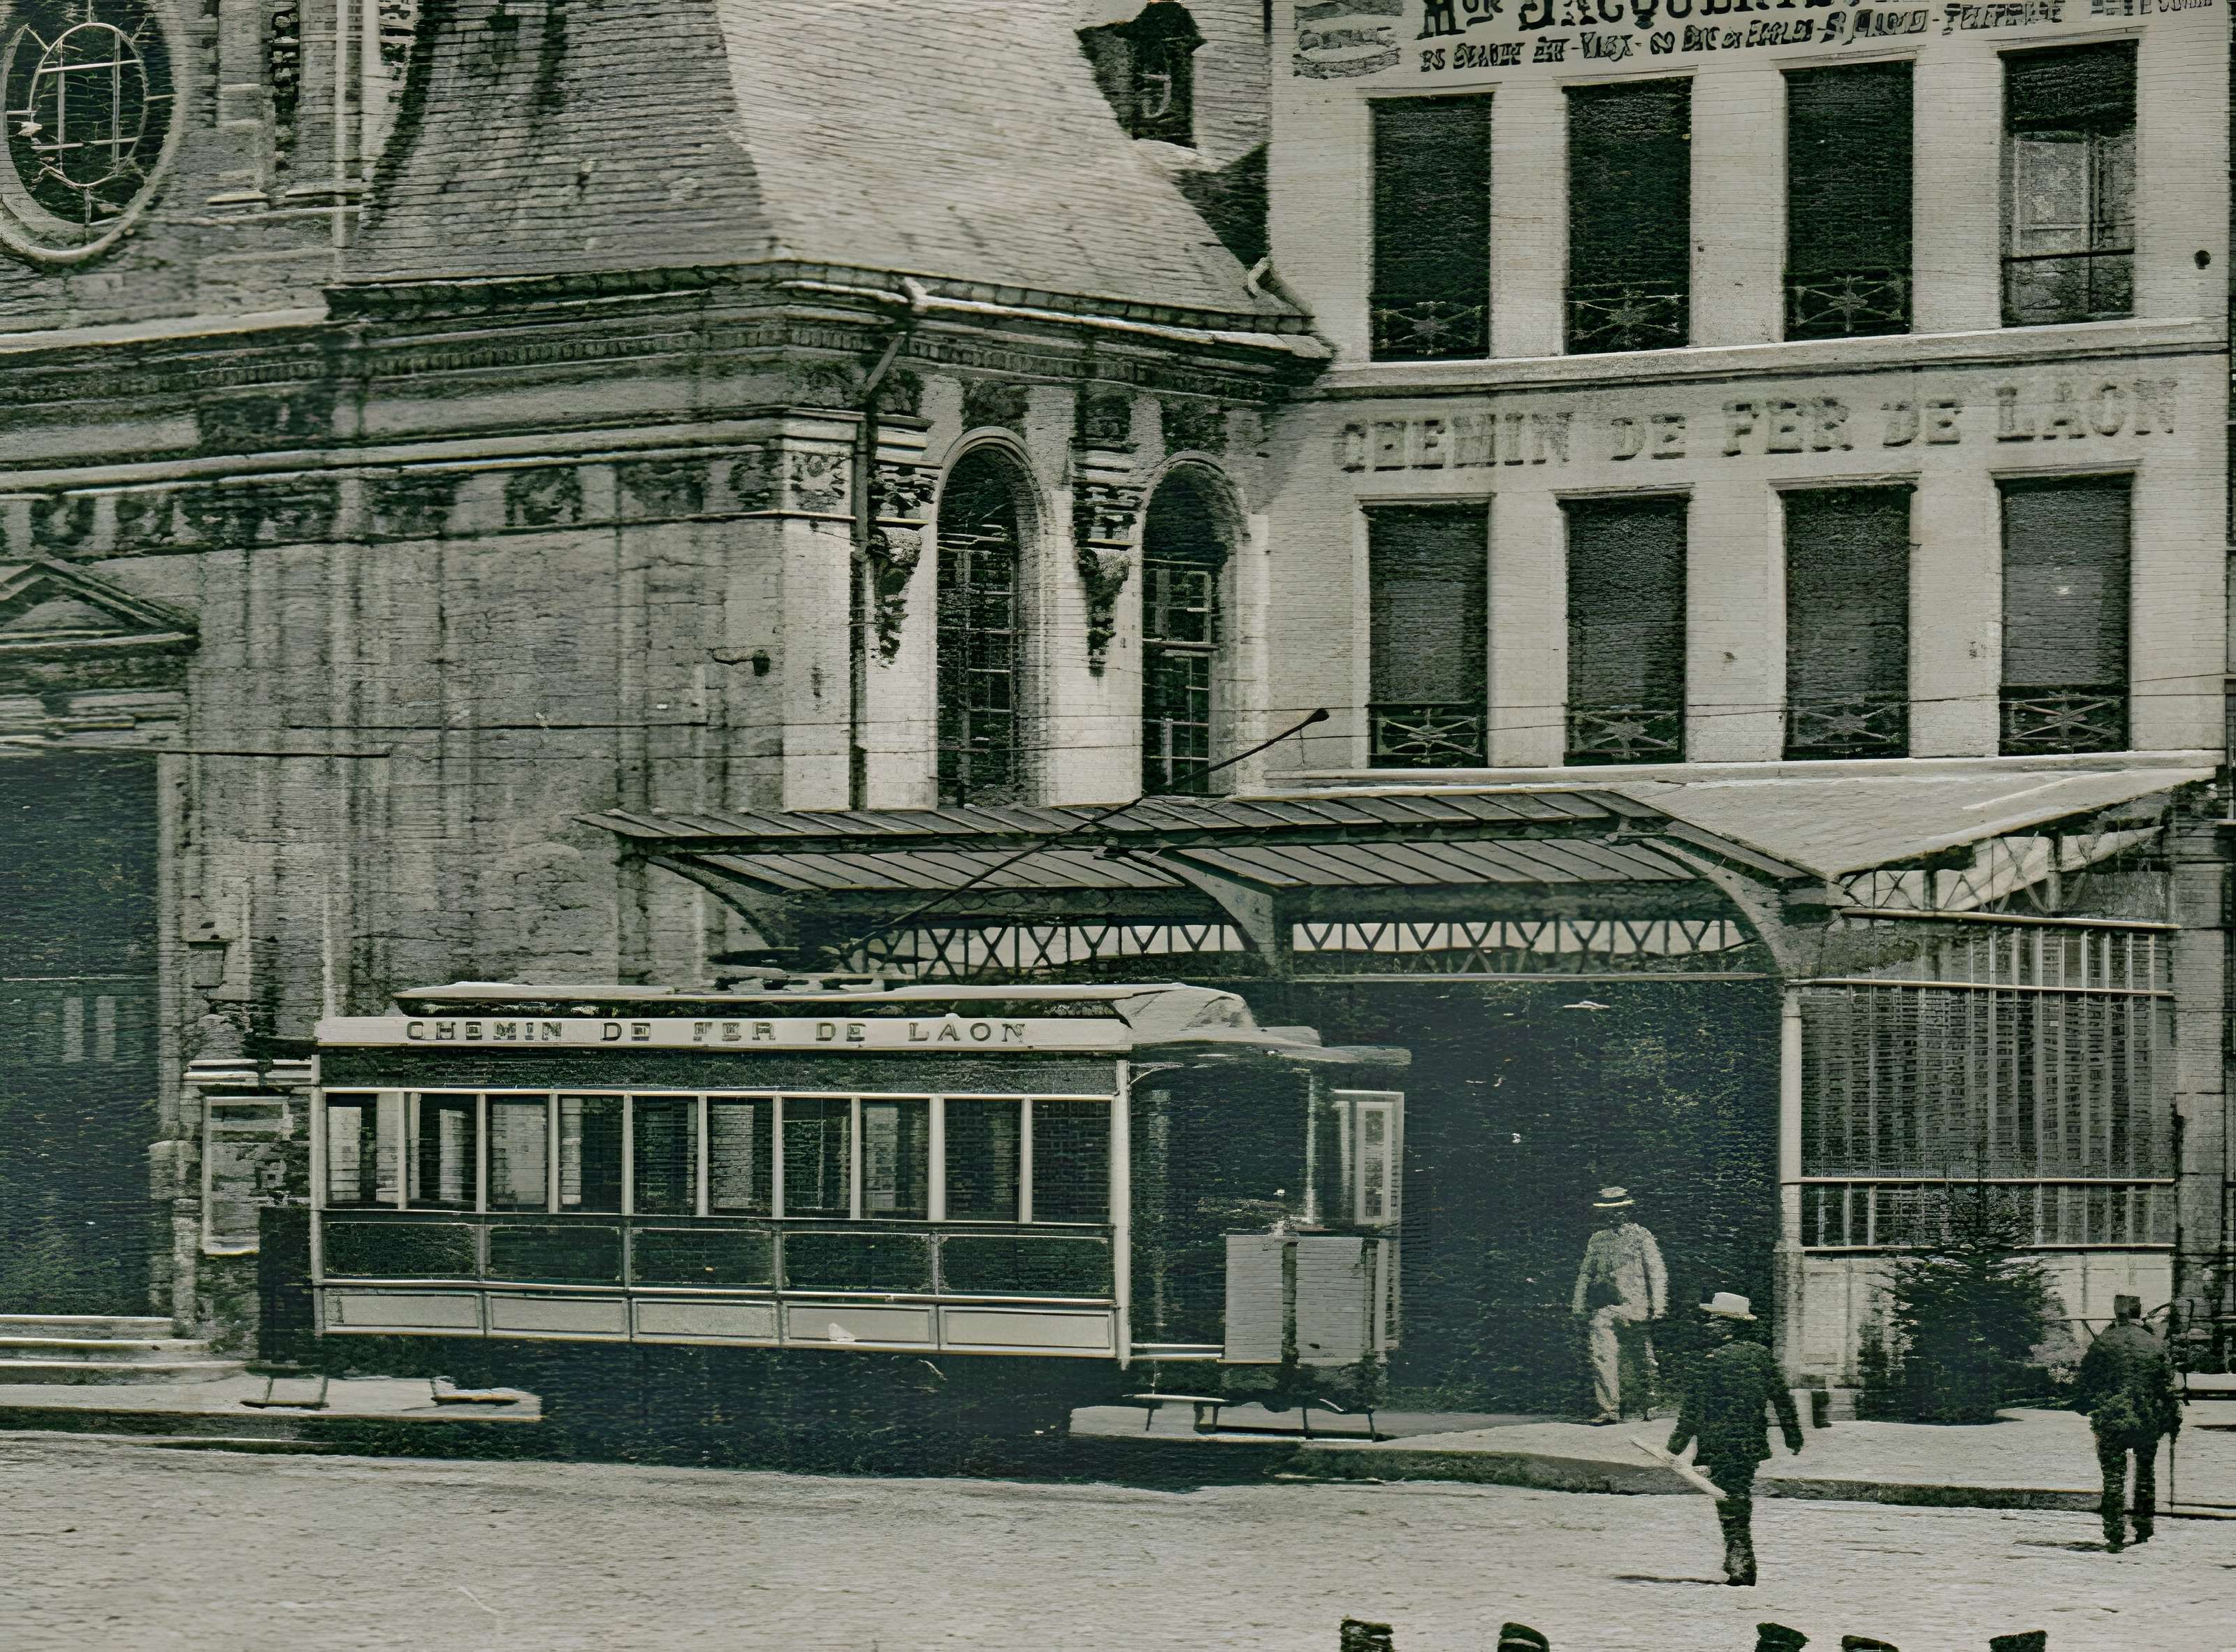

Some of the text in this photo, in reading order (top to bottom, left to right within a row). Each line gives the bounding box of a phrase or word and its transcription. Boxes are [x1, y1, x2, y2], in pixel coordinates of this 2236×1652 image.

[1340, 379, 2177, 472] CHEMIN DE FER DE LAON
[407, 1021, 562, 1041] CHEMIN
[601, 1022, 651, 1041] DE
[815, 1022, 866, 1042] DE
[908, 1022, 1025, 1043] LAON
